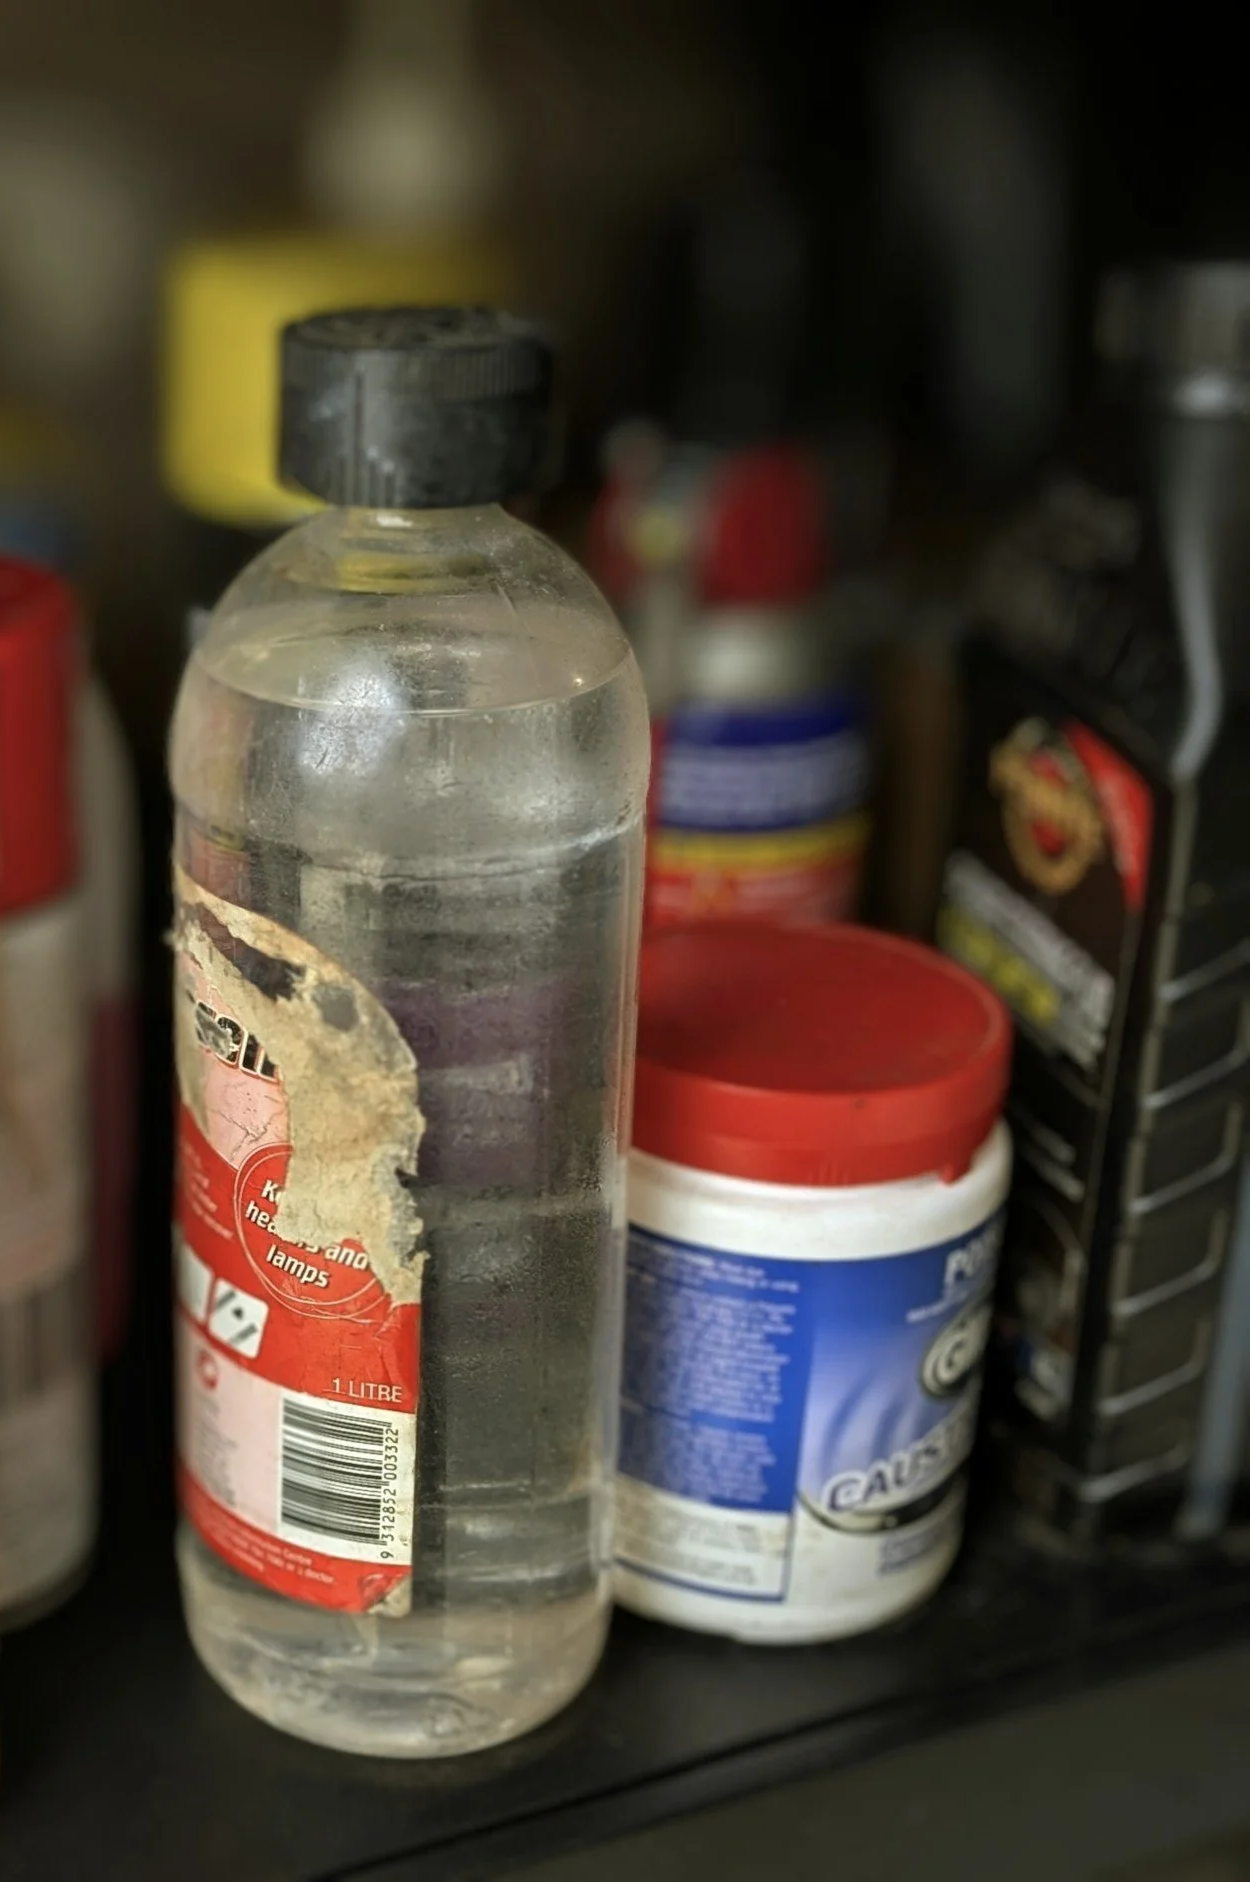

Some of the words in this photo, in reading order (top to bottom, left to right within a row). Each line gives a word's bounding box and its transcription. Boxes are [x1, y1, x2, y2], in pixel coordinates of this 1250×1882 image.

[265, 1244, 330, 1287] lamps
[324, 1241, 369, 1271] and
[333, 1378, 342, 1394] 1
[349, 1380, 403, 1403] LITRE
[384, 1427, 400, 1480] 003322
[382, 1487, 398, 1541] 312852
[381, 1550, 393, 1559] 9
